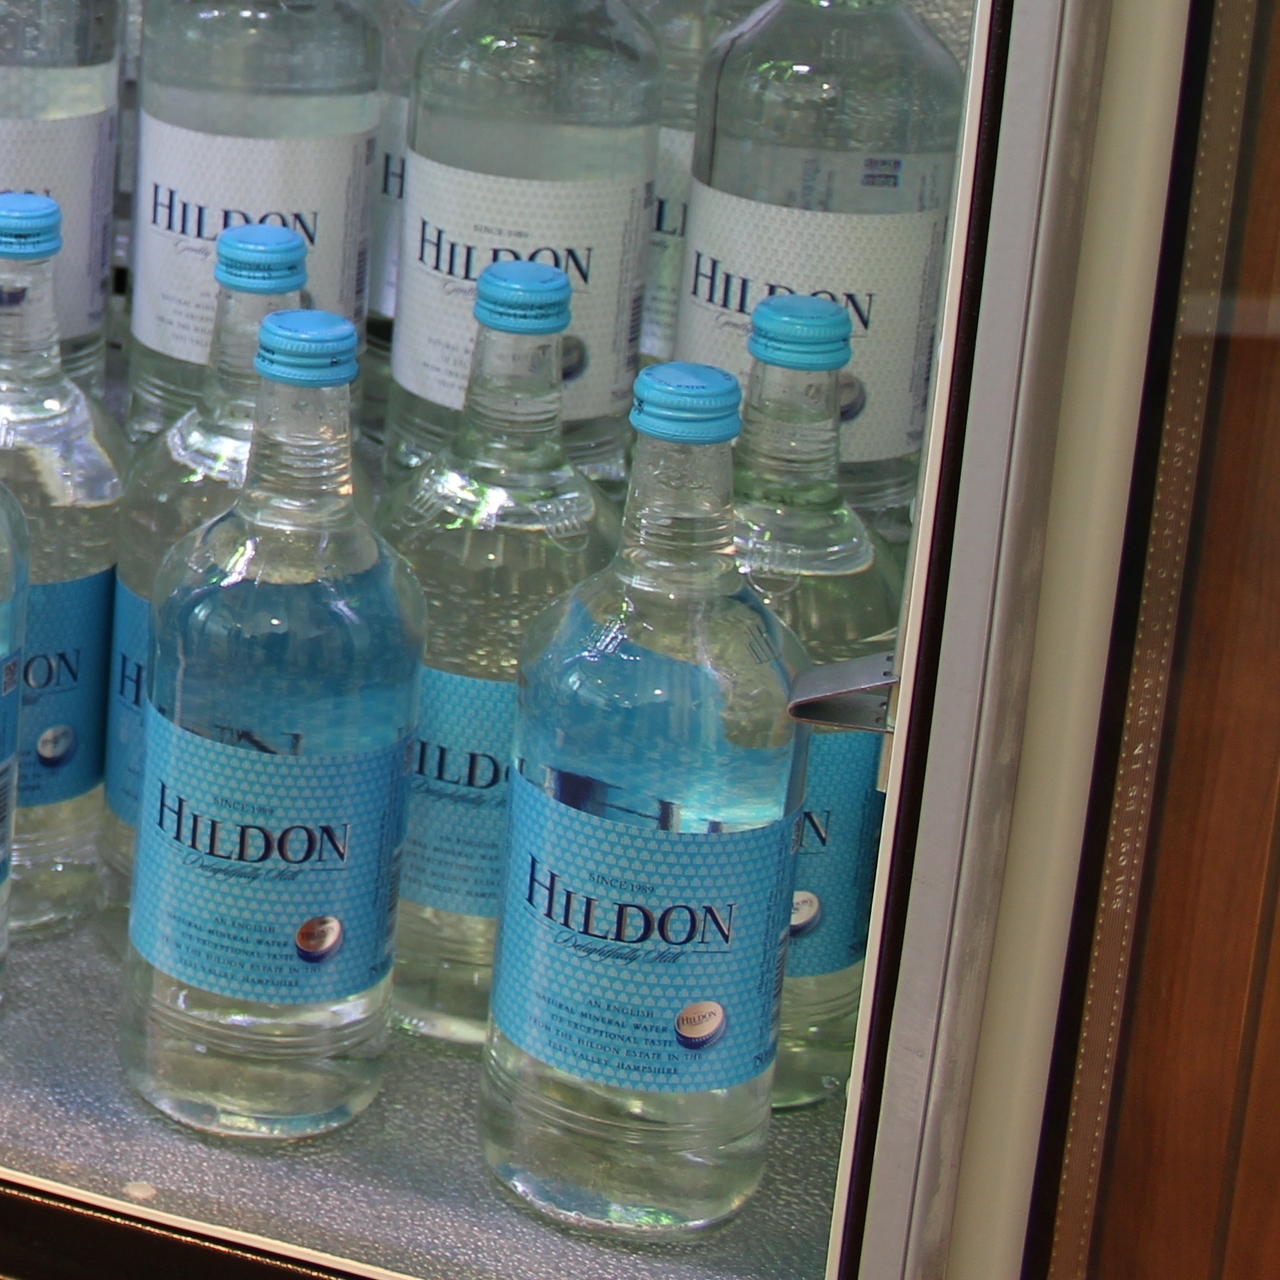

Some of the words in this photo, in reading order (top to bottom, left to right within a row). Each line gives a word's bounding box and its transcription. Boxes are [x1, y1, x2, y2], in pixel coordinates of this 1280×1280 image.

[214, 796, 248, 813] SINCE
[156, 778, 352, 865] HILDON
[182, 851, 263, 885] Delightfully
[589, 872, 628, 891] SINCE
[629, 882, 656, 895] 1989
[525, 852, 738, 946] HILDON
[207, 929, 250, 945] MINERAL
[255, 938, 290, 949] WATER
[231, 921, 277, 934] ENGLISH
[196, 938, 263, 960] EXCEPTIONAL
[553, 929, 641, 967] Delightfully
[642, 948, 687, 965] Still
[249, 963, 285, 976] ESTATE
[241, 975, 300, 989] HAMPSHIRE
[534, 991, 576, 1016] NATURAL
[580, 1010, 628, 1030] MINERAL
[632, 1022, 669, 1034] WATER
[587, 998, 602, 1009] AN
[606, 1004, 655, 1019] ENGLISH
[680, 1009, 718, 1027] HILDON
[555, 1029, 575, 1042] THE
[577, 1036, 621, 1056] HILDON
[625, 1048, 663, 1061] ESTATE
[667, 1053, 680, 1062] IN
[684, 1052, 704, 1061] THE
[567, 1020, 640, 1046] EXCEPTIONAL
[643, 1038, 675, 1048] TASTE
[547, 1039, 568, 1054] TEST
[616, 1061, 679, 1076] HAMPSHIRE
